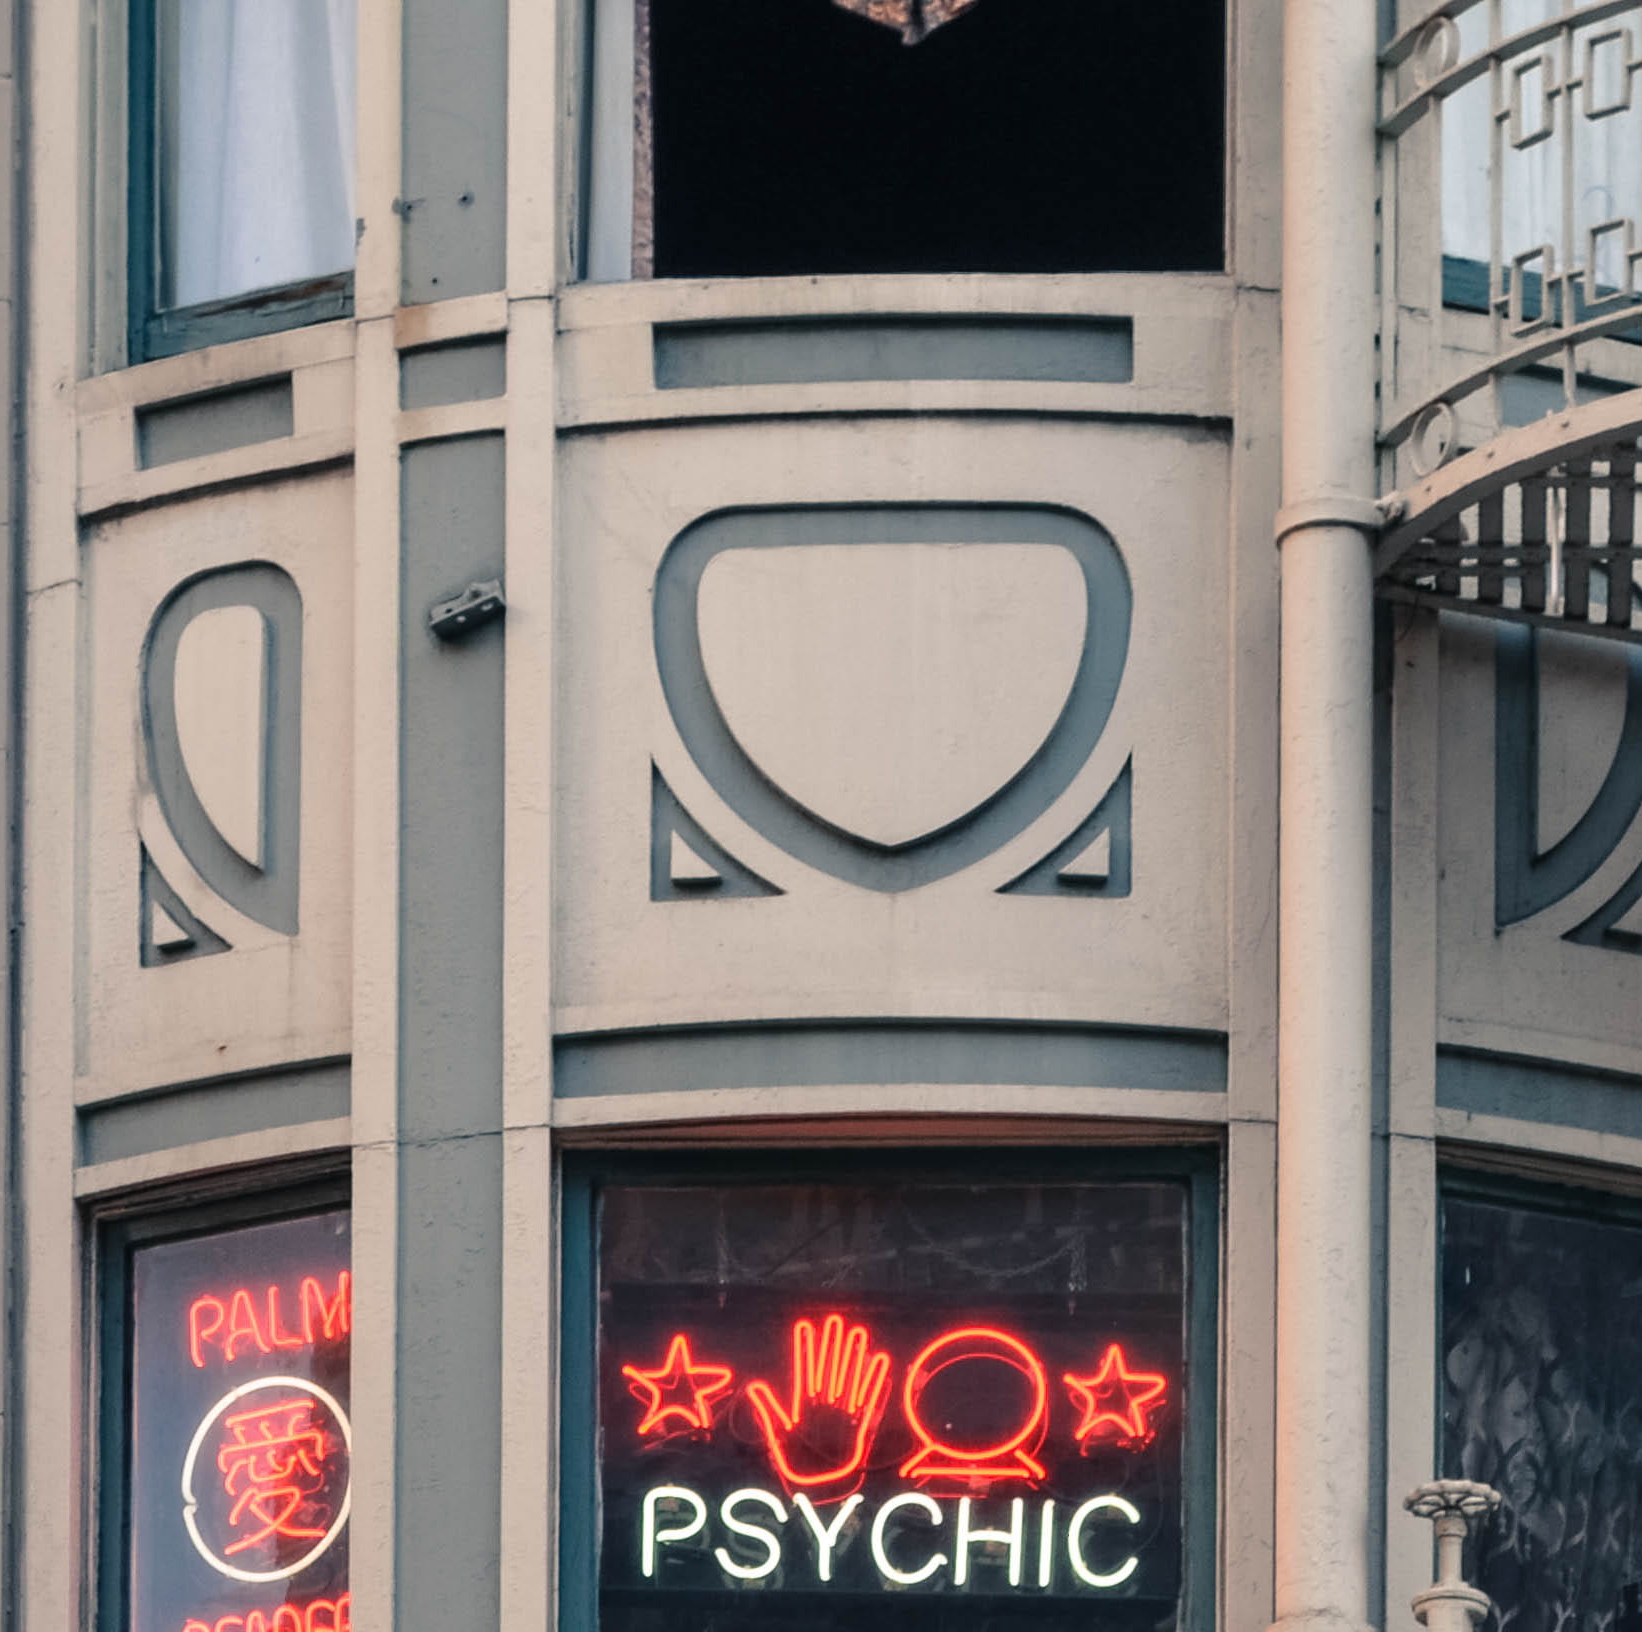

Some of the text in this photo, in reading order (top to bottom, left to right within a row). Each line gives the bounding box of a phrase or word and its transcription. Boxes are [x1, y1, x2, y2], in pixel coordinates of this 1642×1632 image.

[190, 1270, 351, 1367] PALM
[218, 1399, 326, 1555] 愛
[642, 1485, 1142, 1587] PSYCHIC
